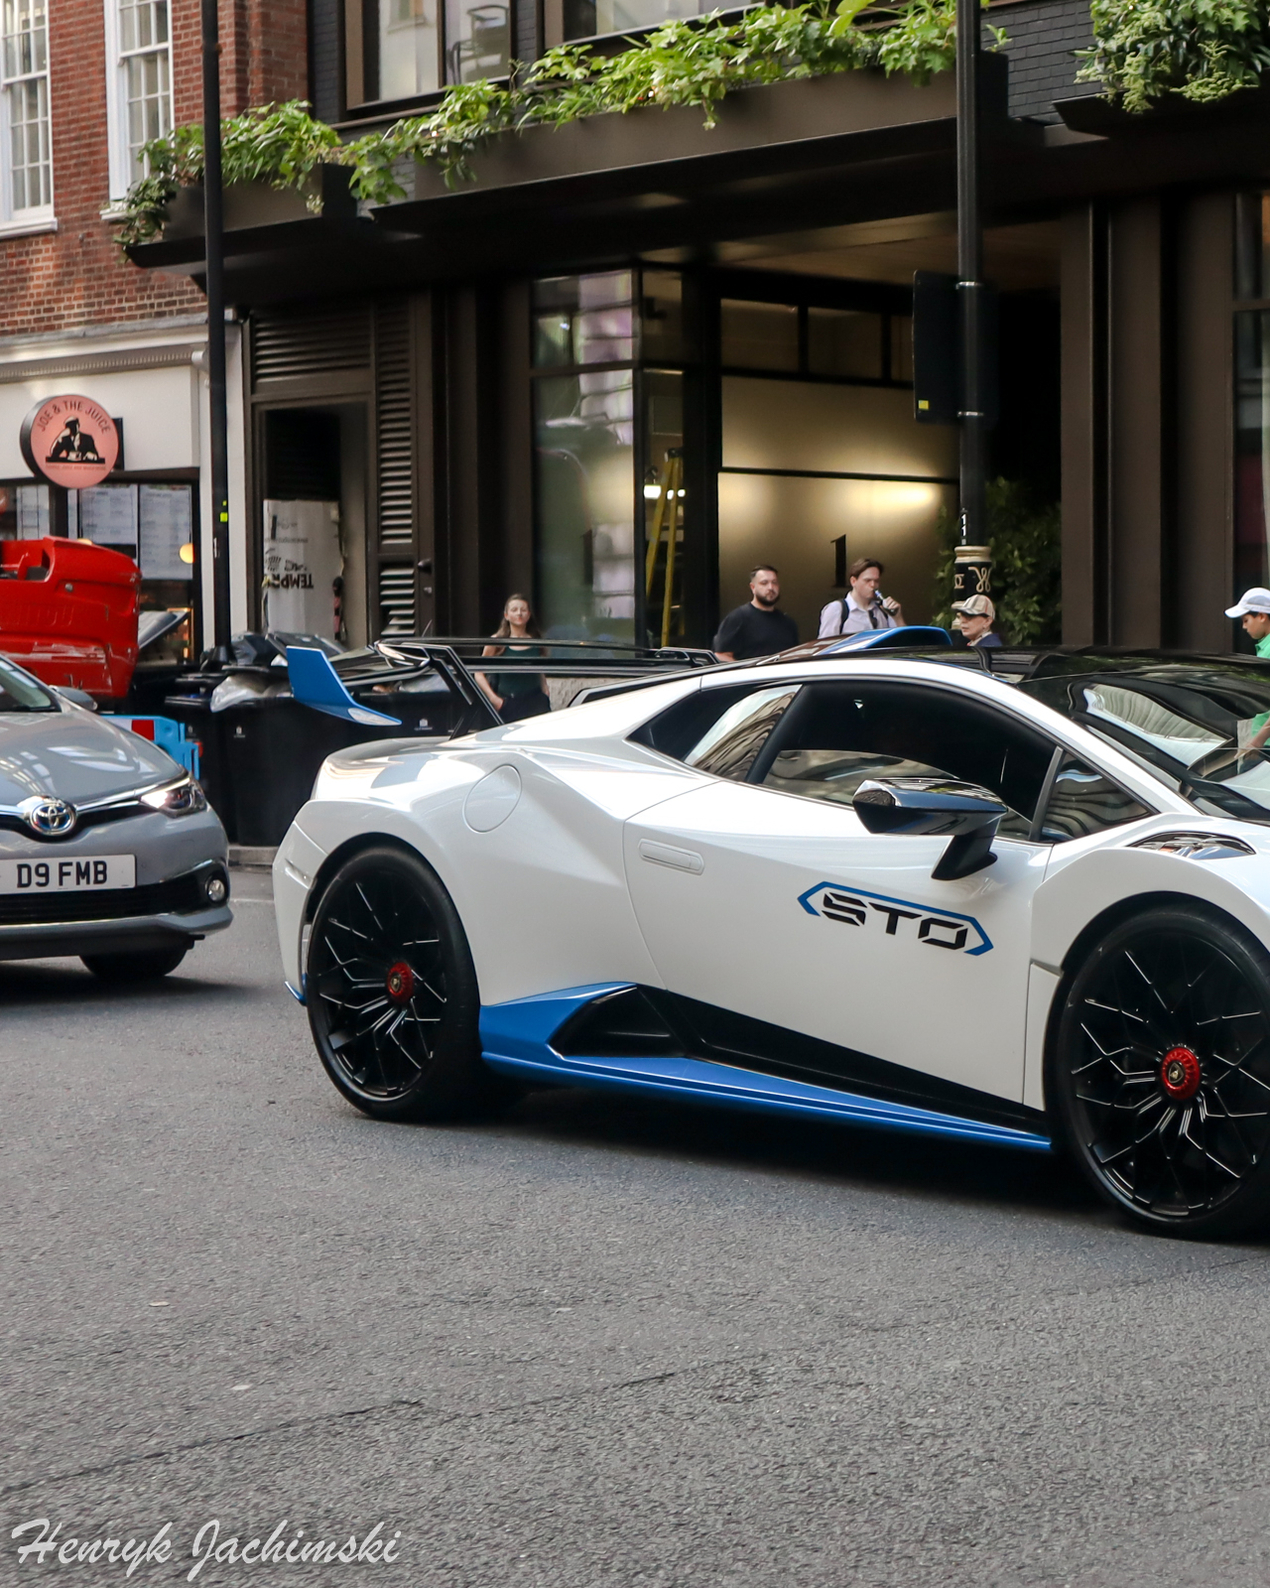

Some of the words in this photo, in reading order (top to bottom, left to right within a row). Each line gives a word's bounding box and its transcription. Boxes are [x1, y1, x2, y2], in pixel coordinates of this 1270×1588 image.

[37, 410, 54, 432] JOE
[52, 404, 61, 414] &
[63, 401, 82, 411] THE
[85, 407, 111, 434] JUICE
[17, 863, 50, 888] D9
[58, 860, 107, 887] FMB
[821, 892, 969, 951] STO
